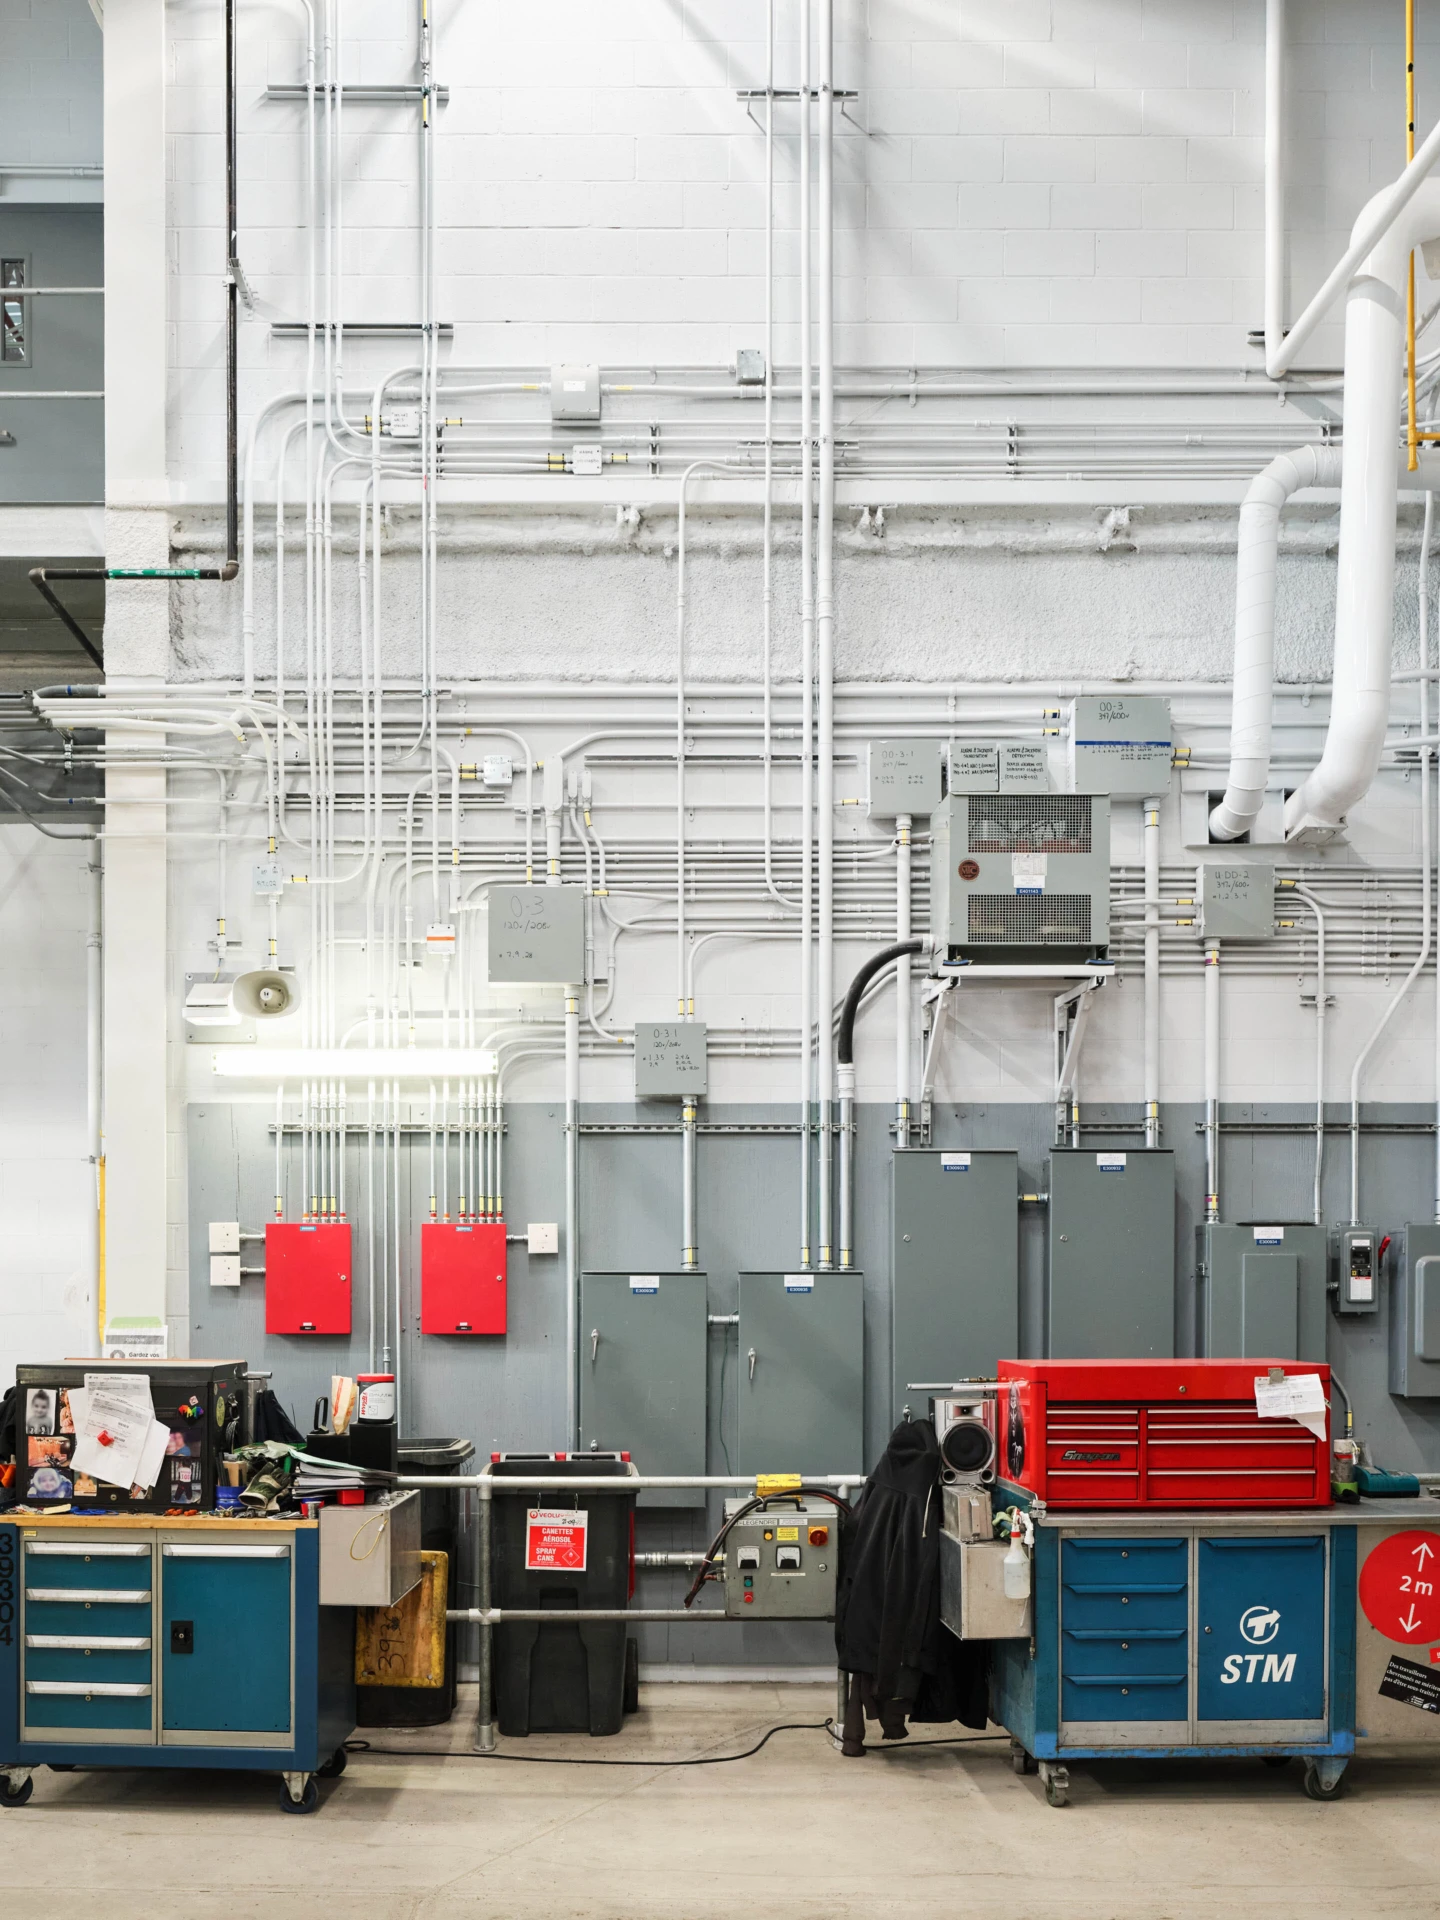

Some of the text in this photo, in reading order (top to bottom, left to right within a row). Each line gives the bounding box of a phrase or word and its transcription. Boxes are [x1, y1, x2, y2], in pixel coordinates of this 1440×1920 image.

[1062, 1449, 1120, 1463] Snap-on
[542, 1534, 571, 1543] AÉROSOL
[536, 1554, 555, 1562] CANS
[1399, 1575, 1433, 1596] 2 m
[1220, 1653, 1297, 1684] STM
[1389, 1661, 1427, 1679] Des travailleurs
